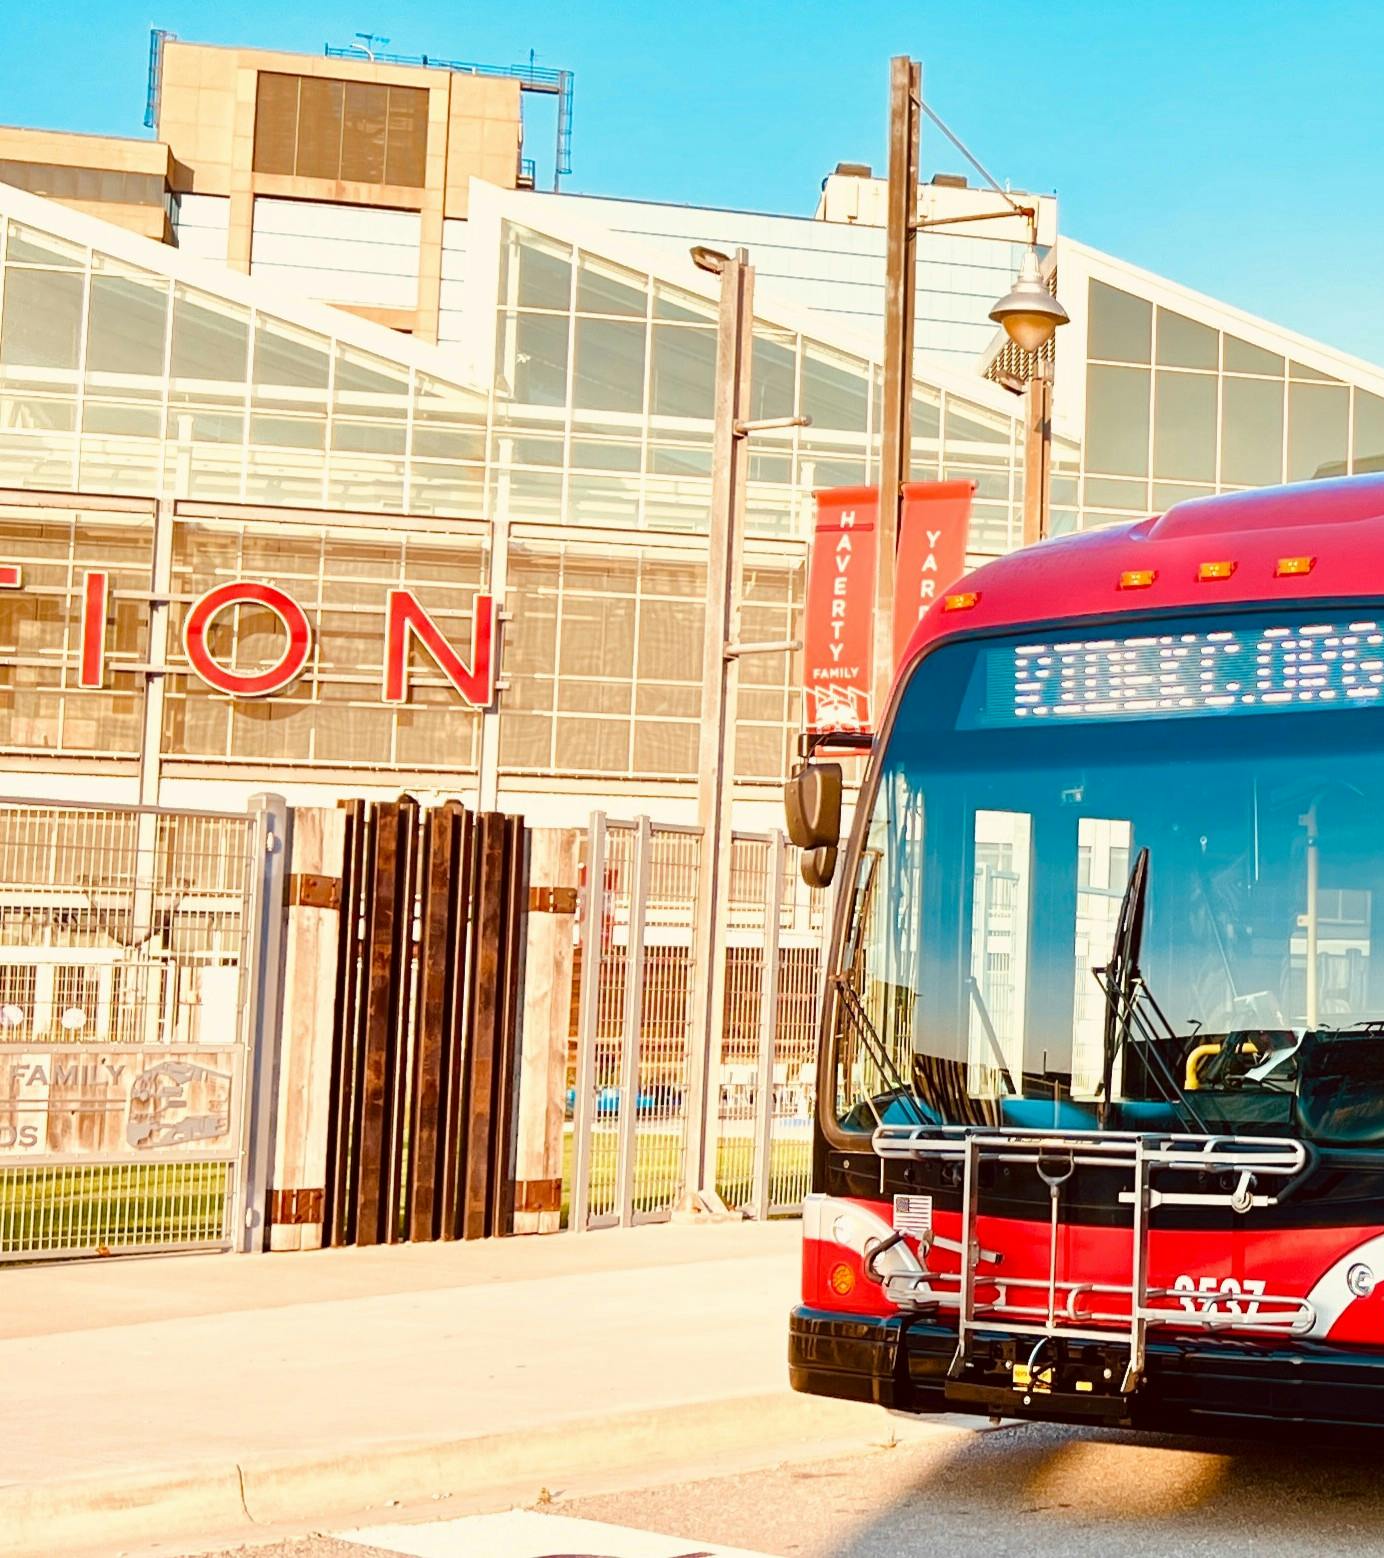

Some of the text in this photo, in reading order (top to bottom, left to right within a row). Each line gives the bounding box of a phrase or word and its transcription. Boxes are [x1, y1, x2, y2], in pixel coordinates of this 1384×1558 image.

[829, 510, 856, 662] HAVERTY
[0, 564, 498, 707] ION
[813, 667, 860, 679] FAMILY
[1014, 621, 1384, 717] RIDEKC.ORG
[9, 1064, 126, 1087] FAMILY
